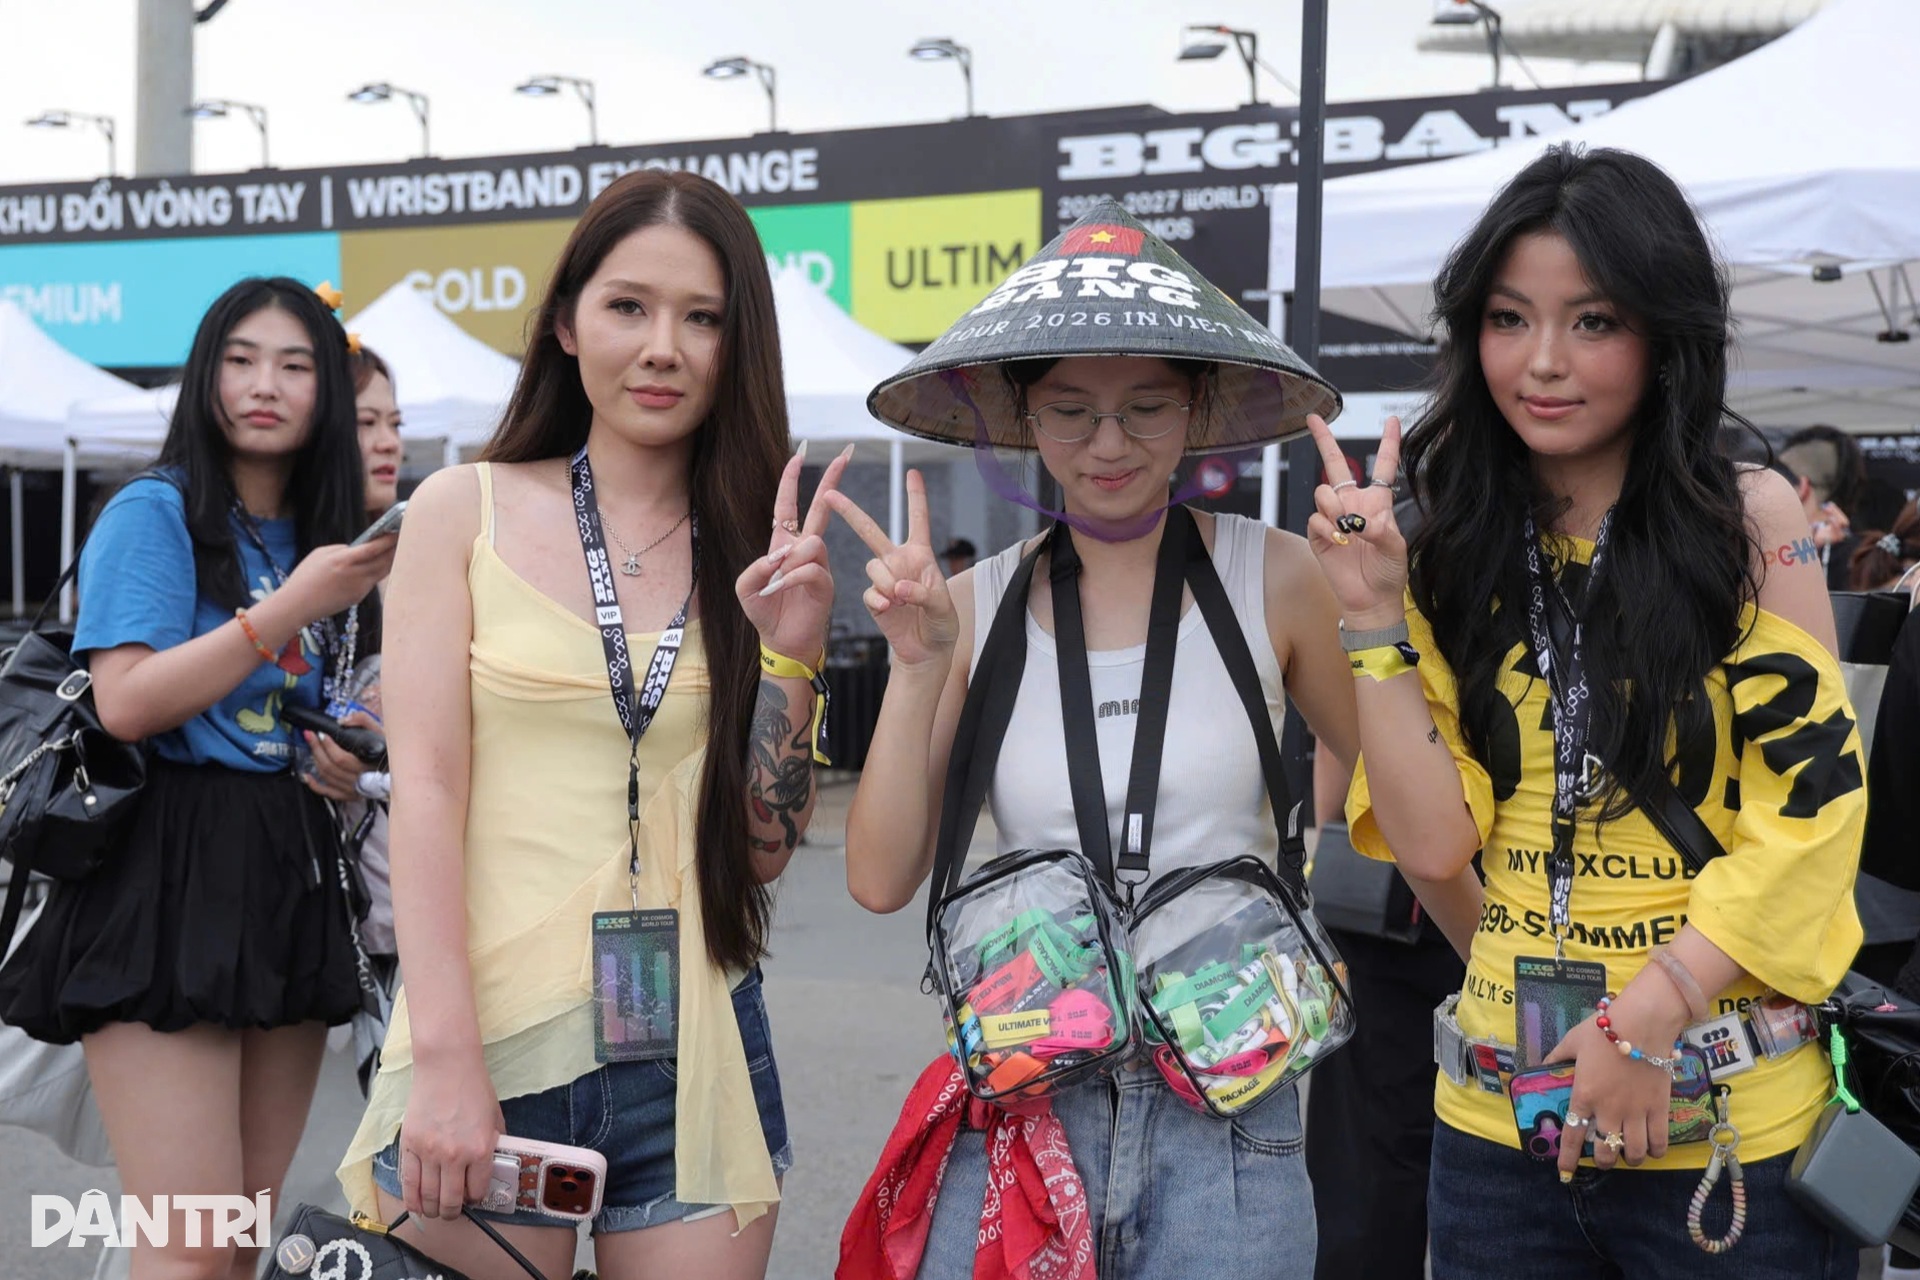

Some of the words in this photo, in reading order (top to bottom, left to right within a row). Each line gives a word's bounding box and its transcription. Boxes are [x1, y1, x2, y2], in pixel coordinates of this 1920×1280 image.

[61, 178, 124, 233] ĐỔI
[127, 179, 233, 230] VÒNG
[237, 181, 306, 225] TAY
[347, 165, 582, 218] WRISTBAND
[588, 148, 819, 202] EANGE
[1182, 185, 1260, 211] WORLD
[998, 256, 1202, 293] BIG
[969, 278, 1201, 316] BANG
[946, 320, 1010, 344] TOUR
[1025, 311, 1111, 330] 2026
[1123, 311, 1159, 327] IN
[1166, 313, 1234, 338] VIET
[600, 611, 617, 621] VIP
[663, 633, 679, 643] VIP
[1194, 969, 1236, 991] DIAMOND
[998, 1018, 1041, 1031] ULTIMATE
[1219, 1077, 1261, 1105] PACKAGE
